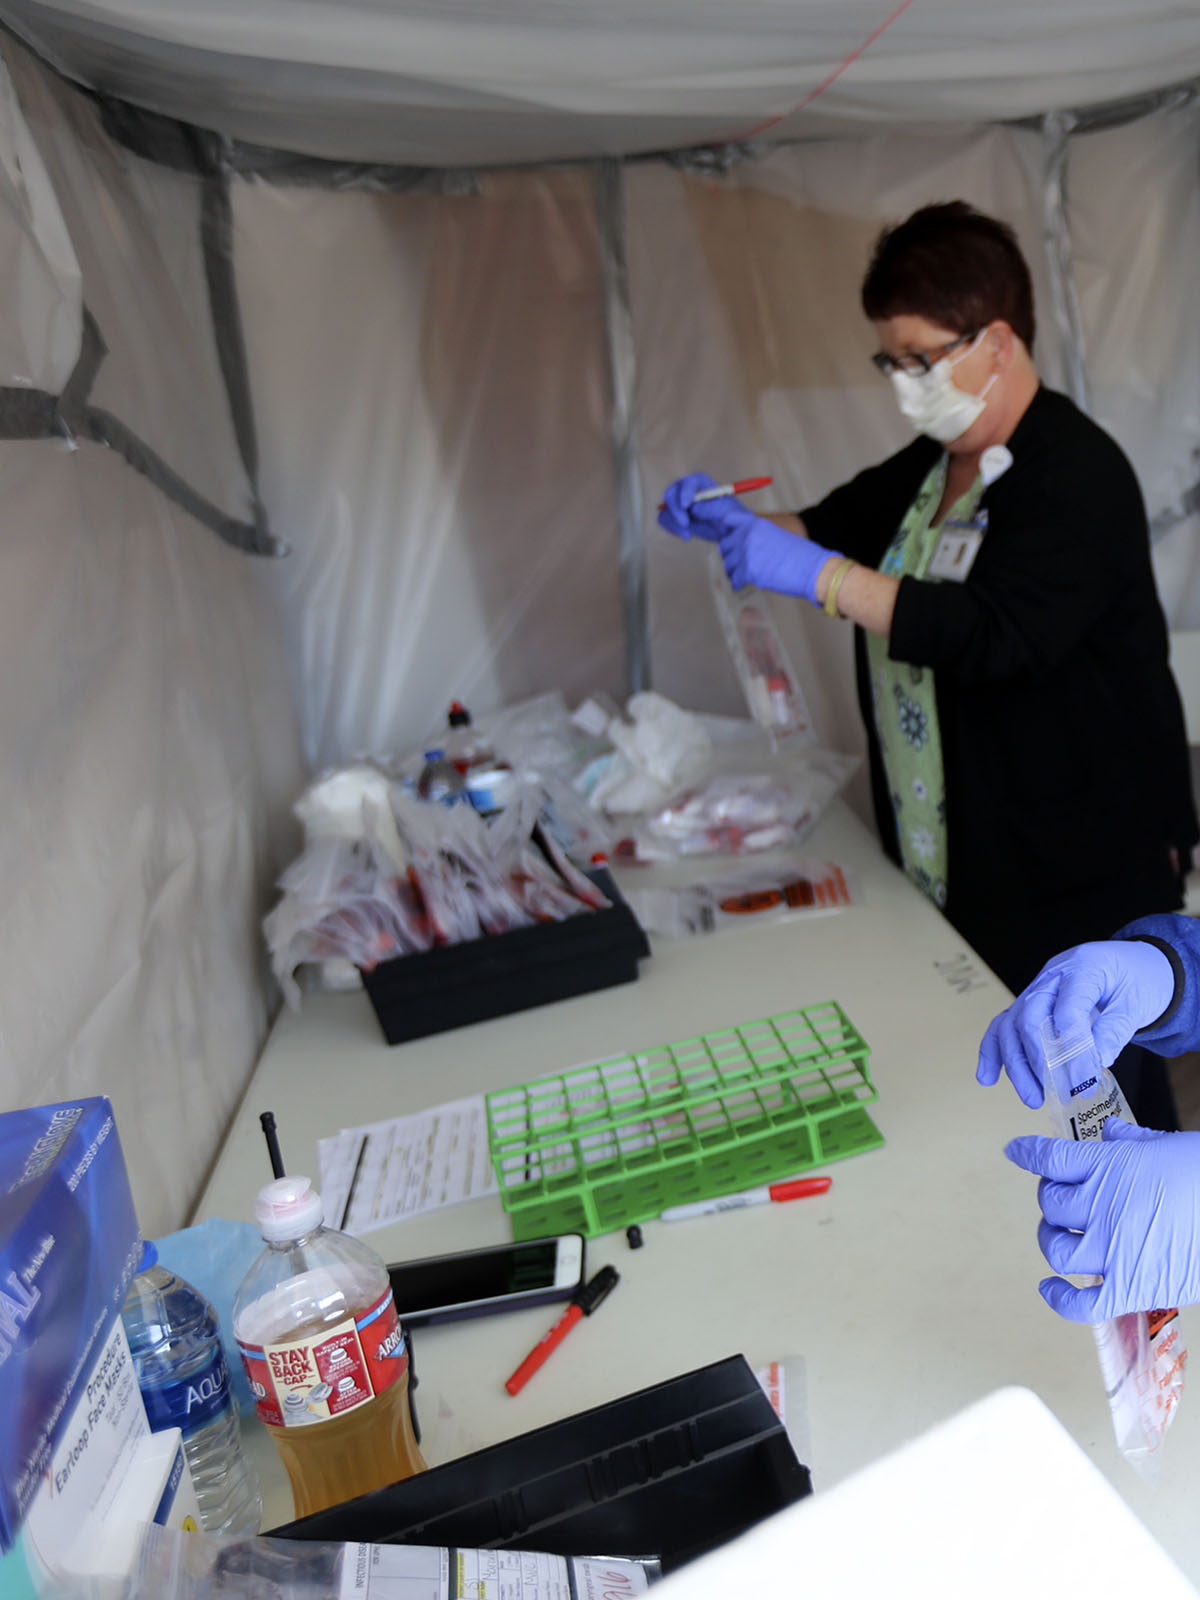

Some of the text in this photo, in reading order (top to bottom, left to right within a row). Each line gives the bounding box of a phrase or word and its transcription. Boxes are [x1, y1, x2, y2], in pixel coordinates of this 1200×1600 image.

[1080, 1125, 1098, 1140] Bag
[269, 1346, 309, 1366] STAY
[87, 1333, 121, 1403] Procedure
[272, 1361, 313, 1378] BACK
[284, 1374, 308, 1385] CAP
[55, 1429, 89, 1494] Earloop
[87, 1394, 106, 1430] Face
[105, 1351, 126, 1393] Masks
